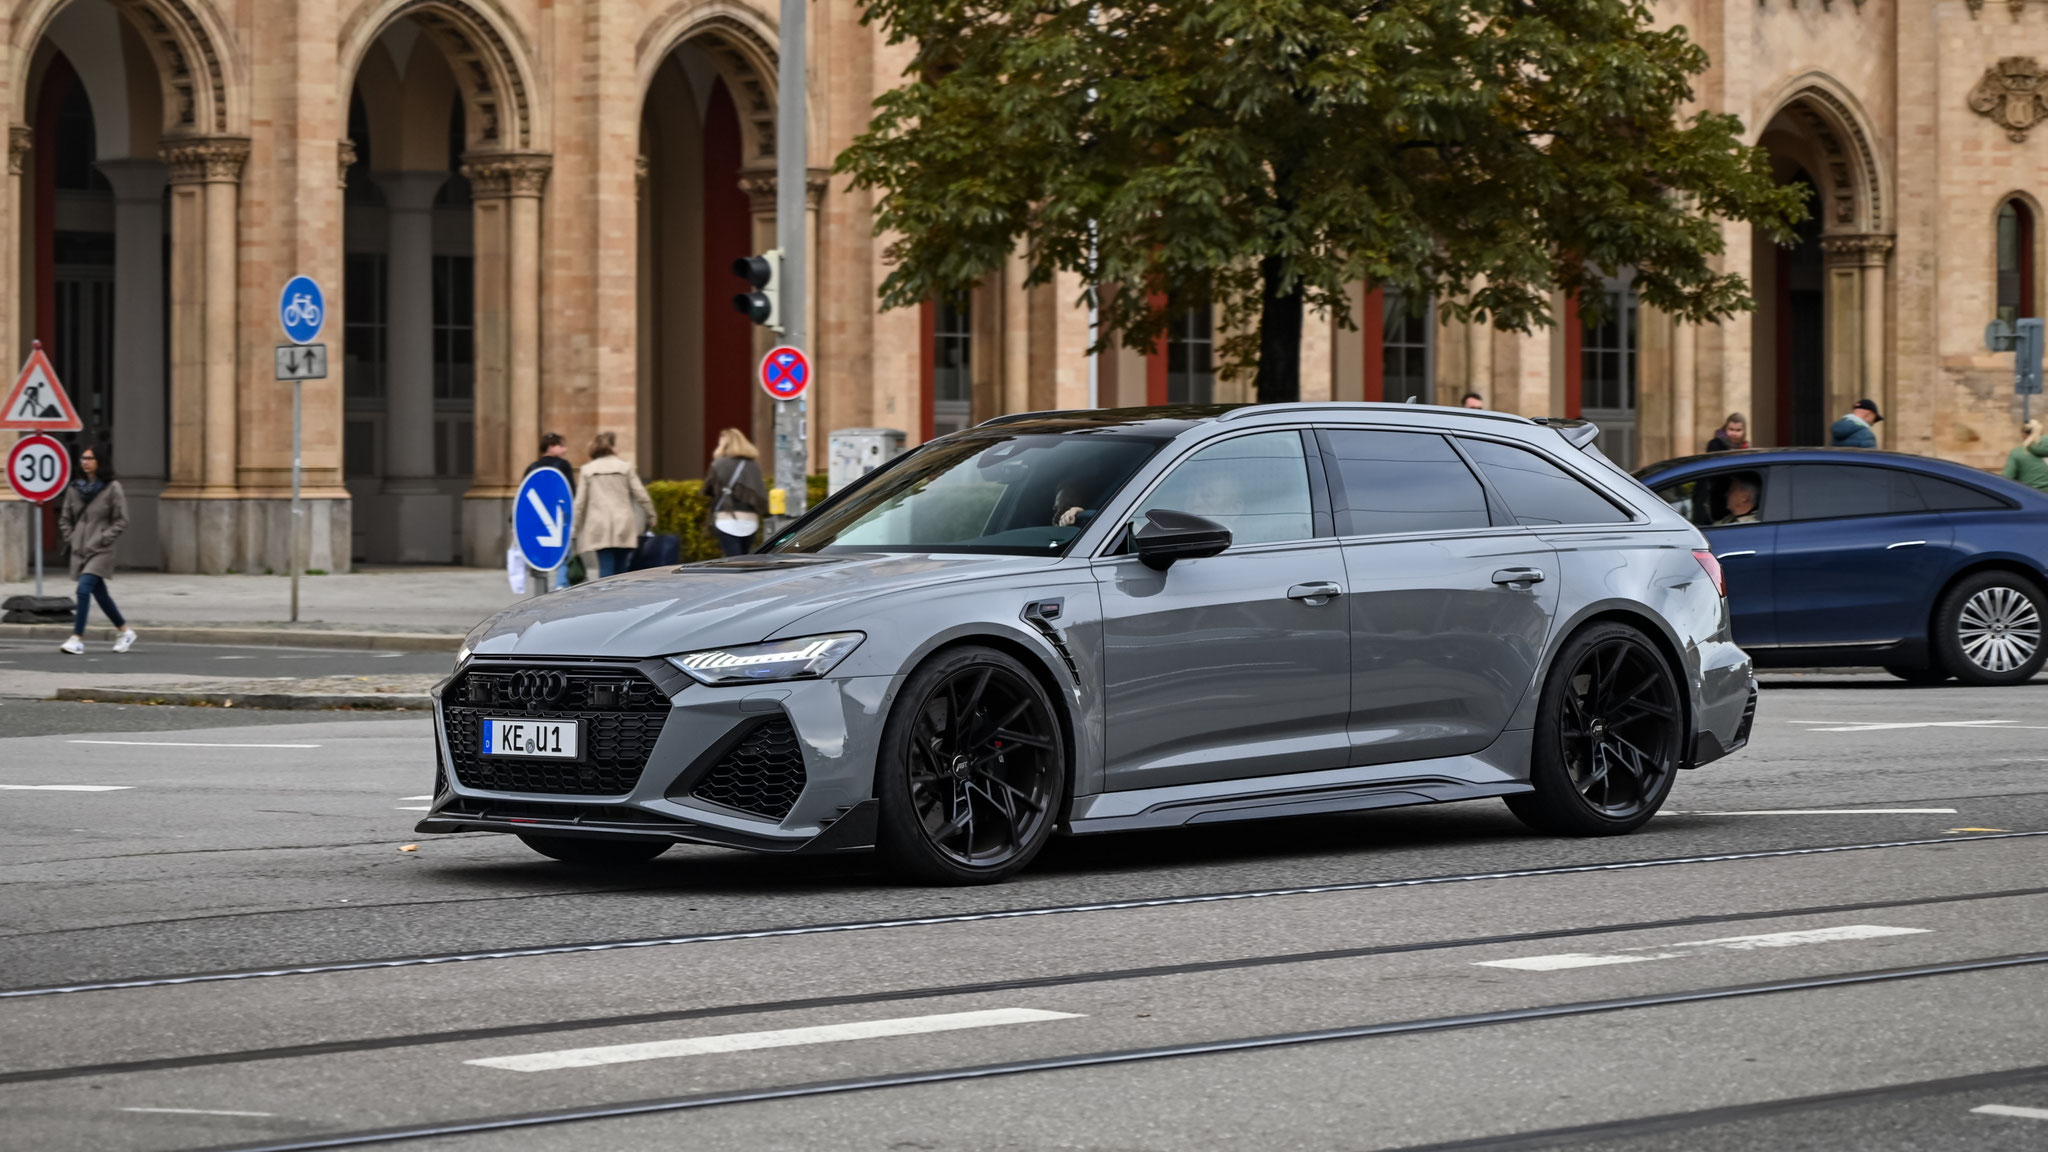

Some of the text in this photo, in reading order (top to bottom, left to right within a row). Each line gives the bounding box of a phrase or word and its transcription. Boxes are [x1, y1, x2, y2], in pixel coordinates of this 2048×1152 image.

[20, 454, 55, 482] 30
[485, 739, 490, 748] D
[502, 724, 562, 753] KE U1
